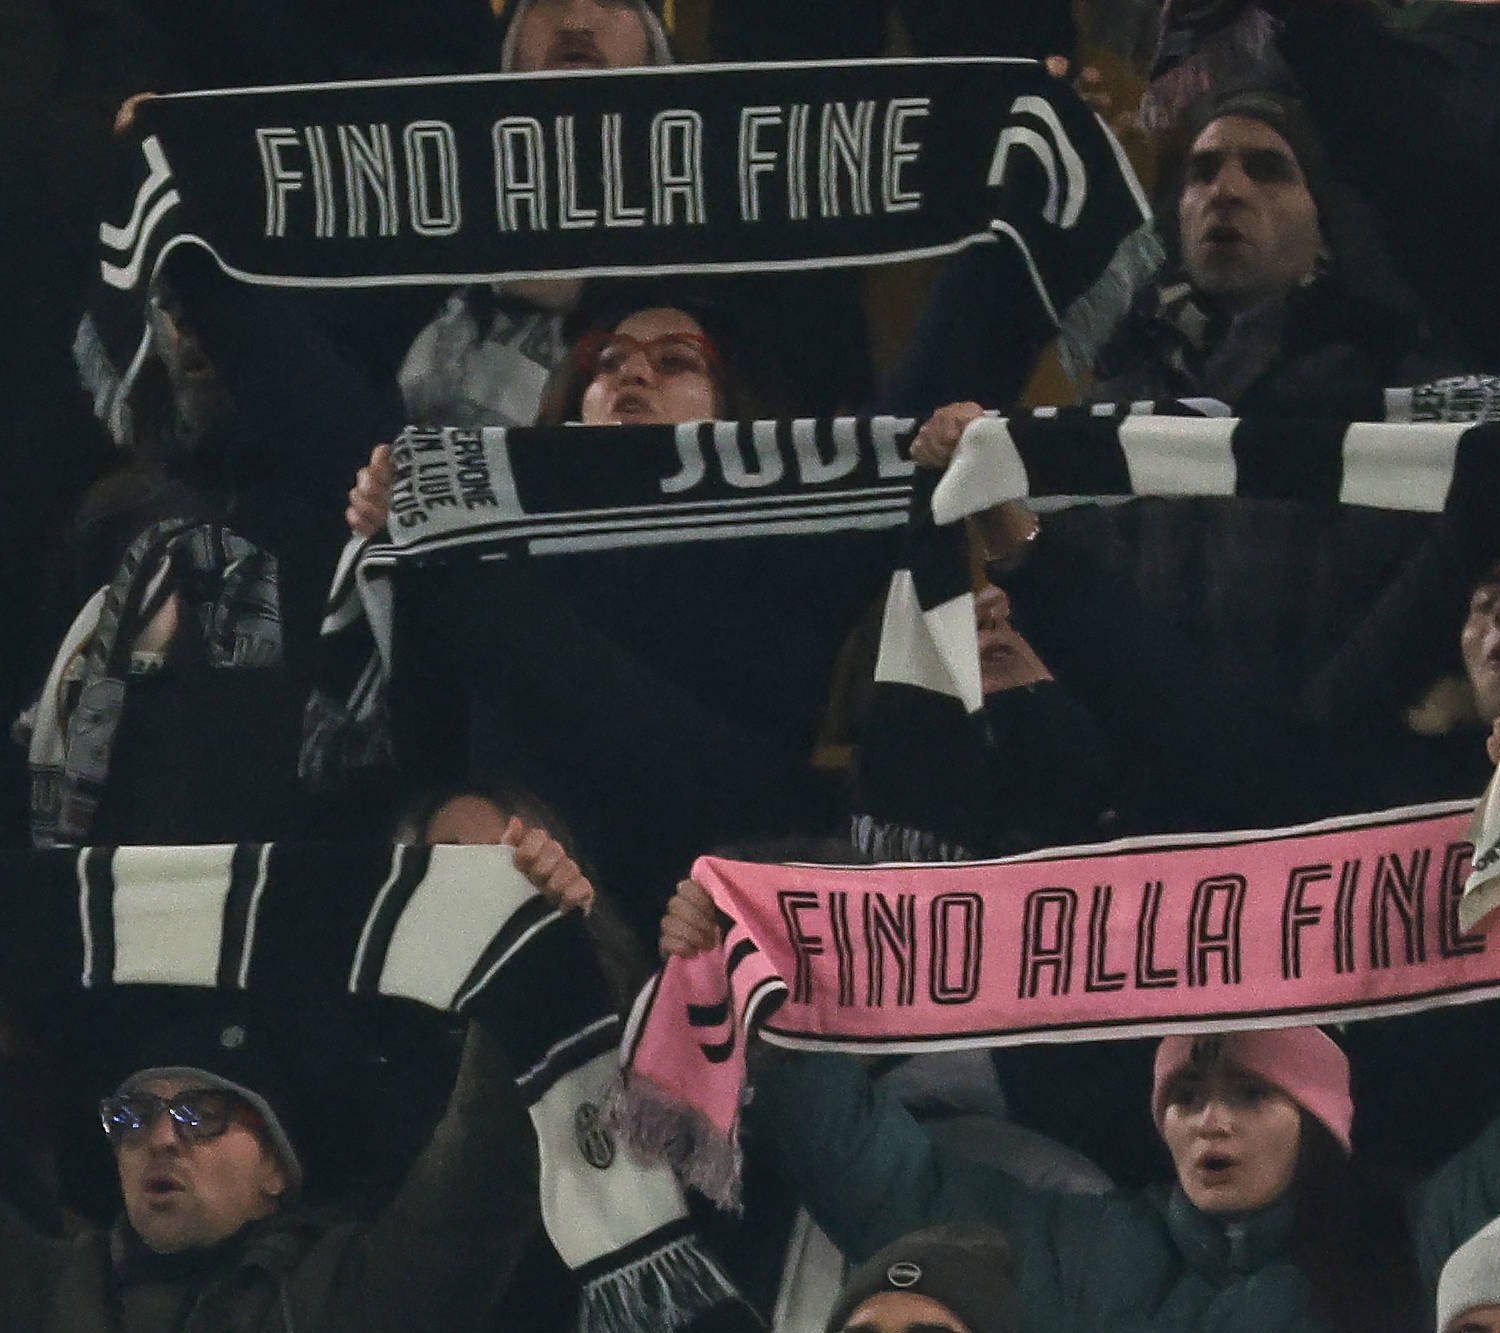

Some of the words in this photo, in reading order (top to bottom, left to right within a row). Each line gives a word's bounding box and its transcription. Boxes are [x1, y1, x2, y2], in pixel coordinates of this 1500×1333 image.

[254, 119, 460, 240] FINO
[491, 107, 706, 233] ALLA
[737, 96, 931, 224] FINE
[774, 886, 986, 1008] FINO
[1017, 870, 1248, 1001] ALLA
[1279, 841, 1487, 980] FINE
